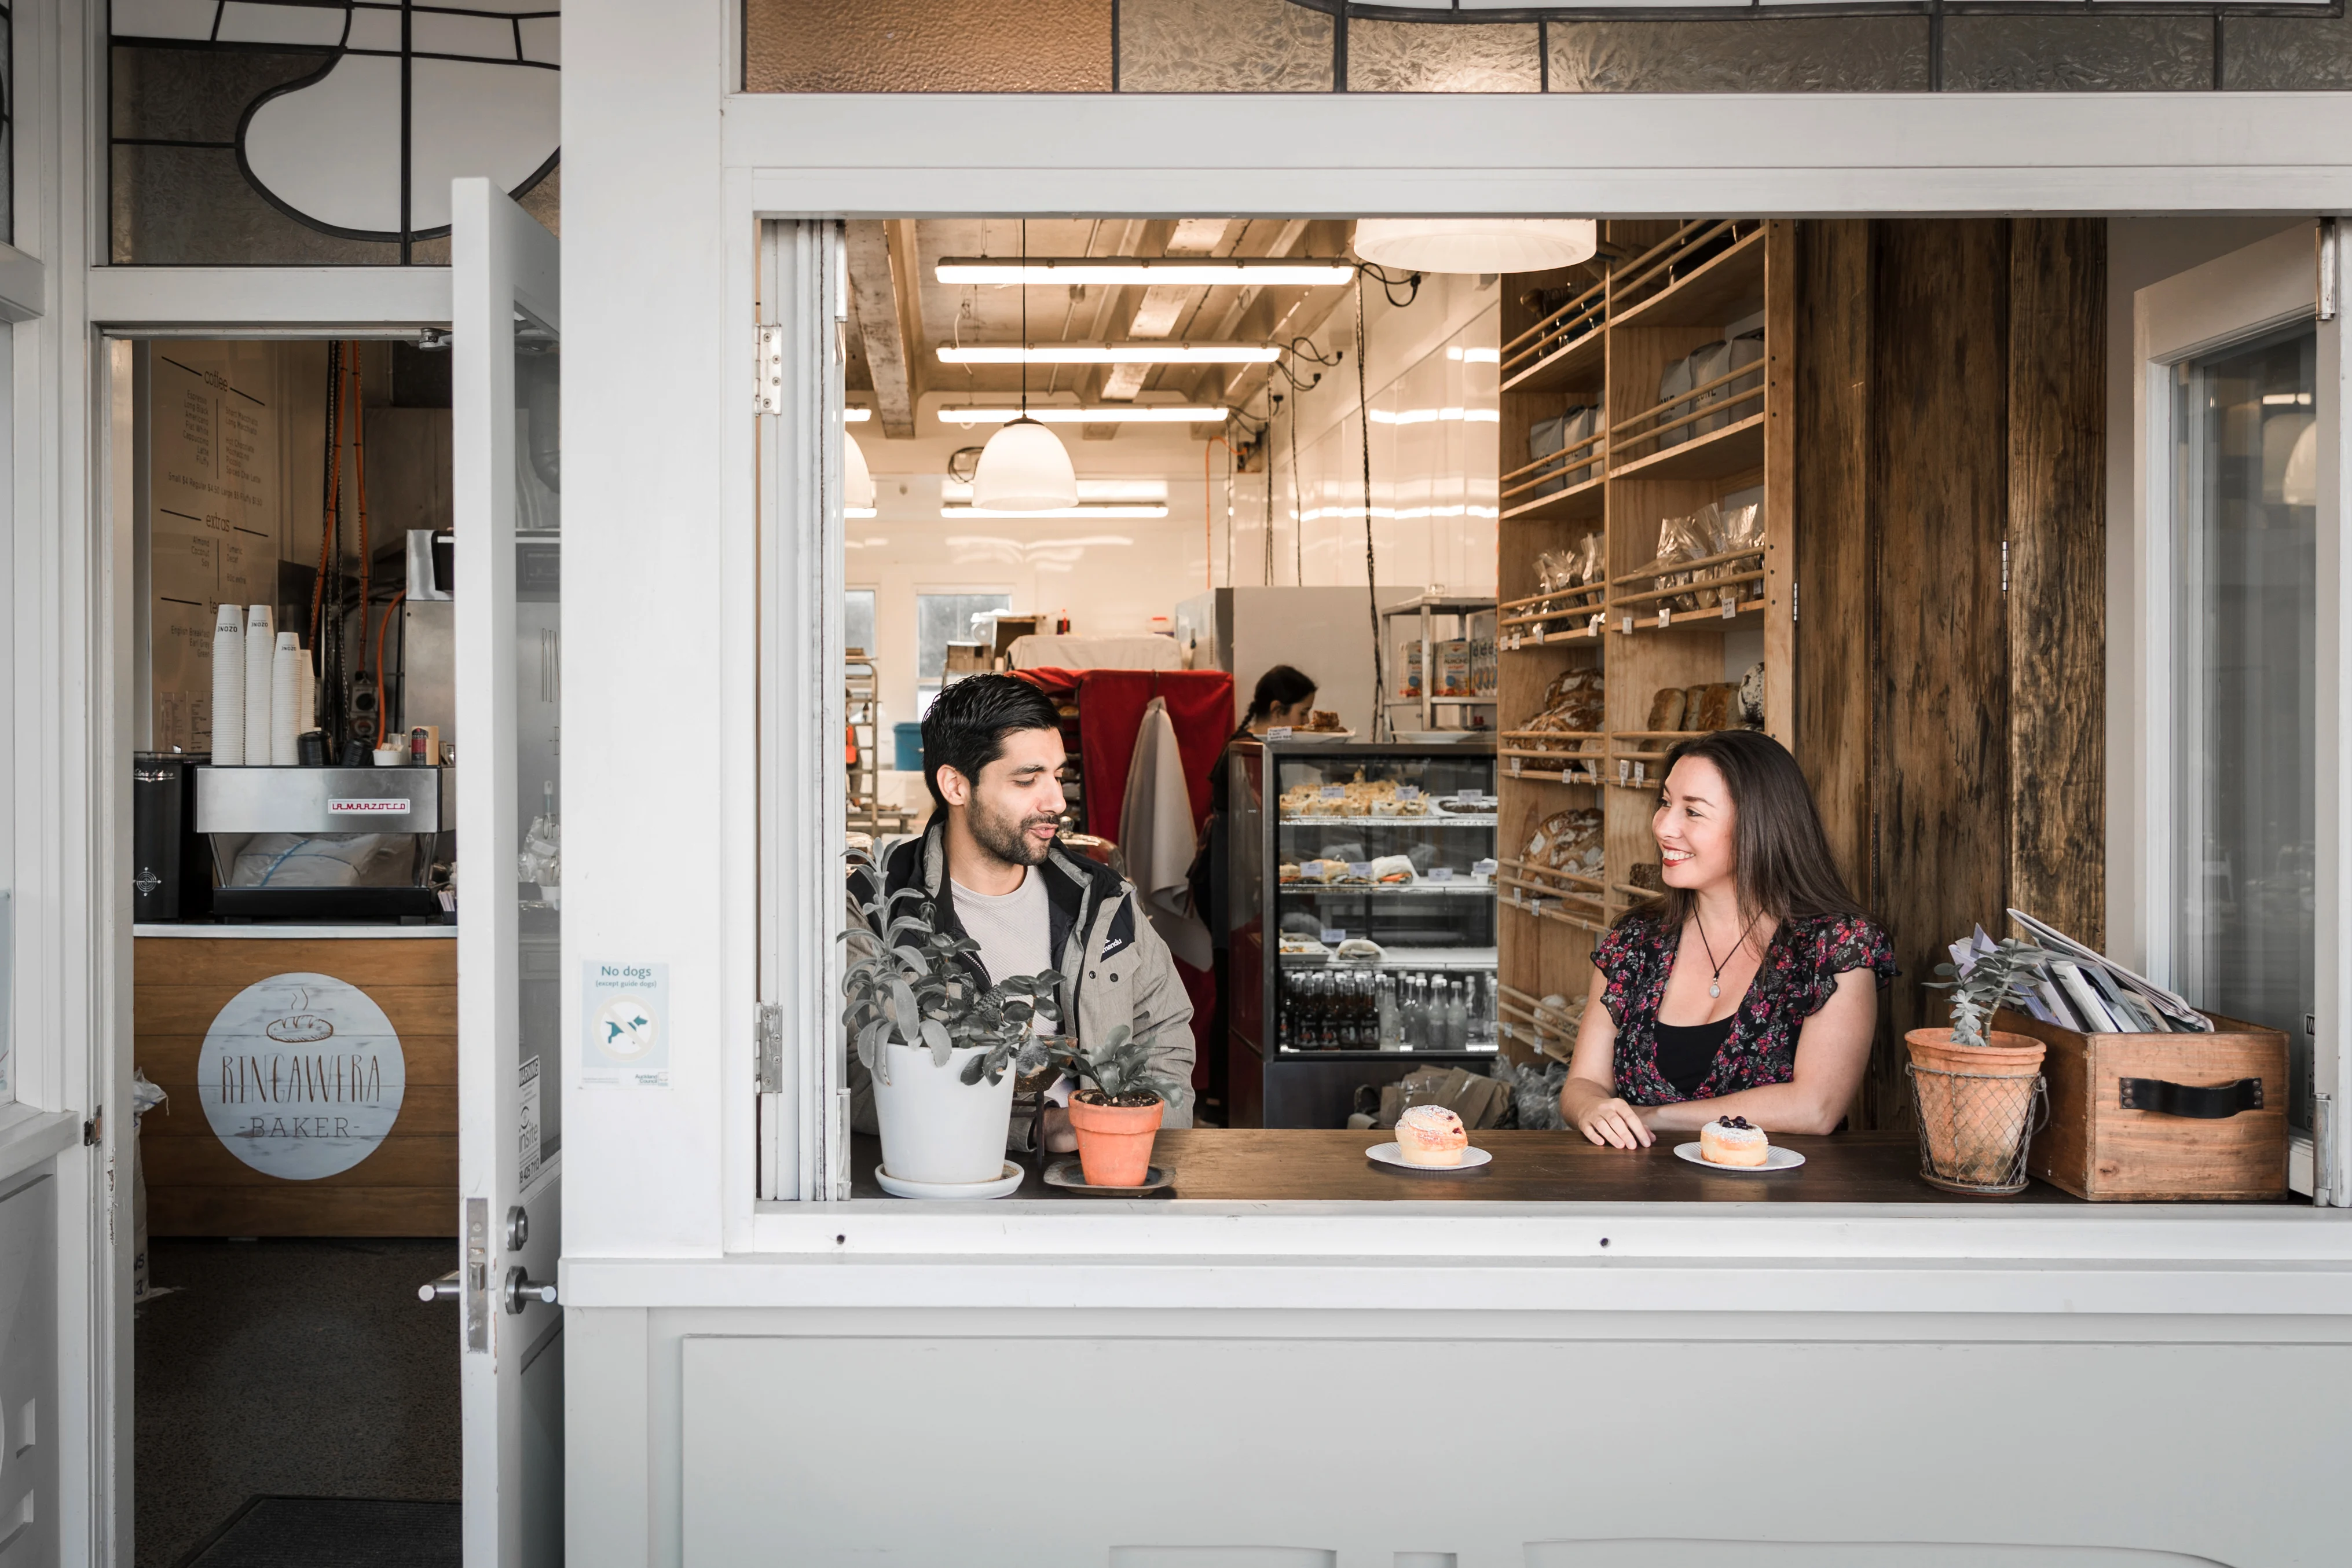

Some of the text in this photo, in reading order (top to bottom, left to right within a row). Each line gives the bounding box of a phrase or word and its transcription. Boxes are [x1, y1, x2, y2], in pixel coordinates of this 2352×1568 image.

[204, 371, 228, 391] coffee
[168, 472, 181, 483] Small
[206, 512, 230, 532] extras
[602, 965, 651, 979] No dogs
[596, 980, 657, 988] (except guide dogs)
[222, 1054, 380, 1104] RINGAWERA
